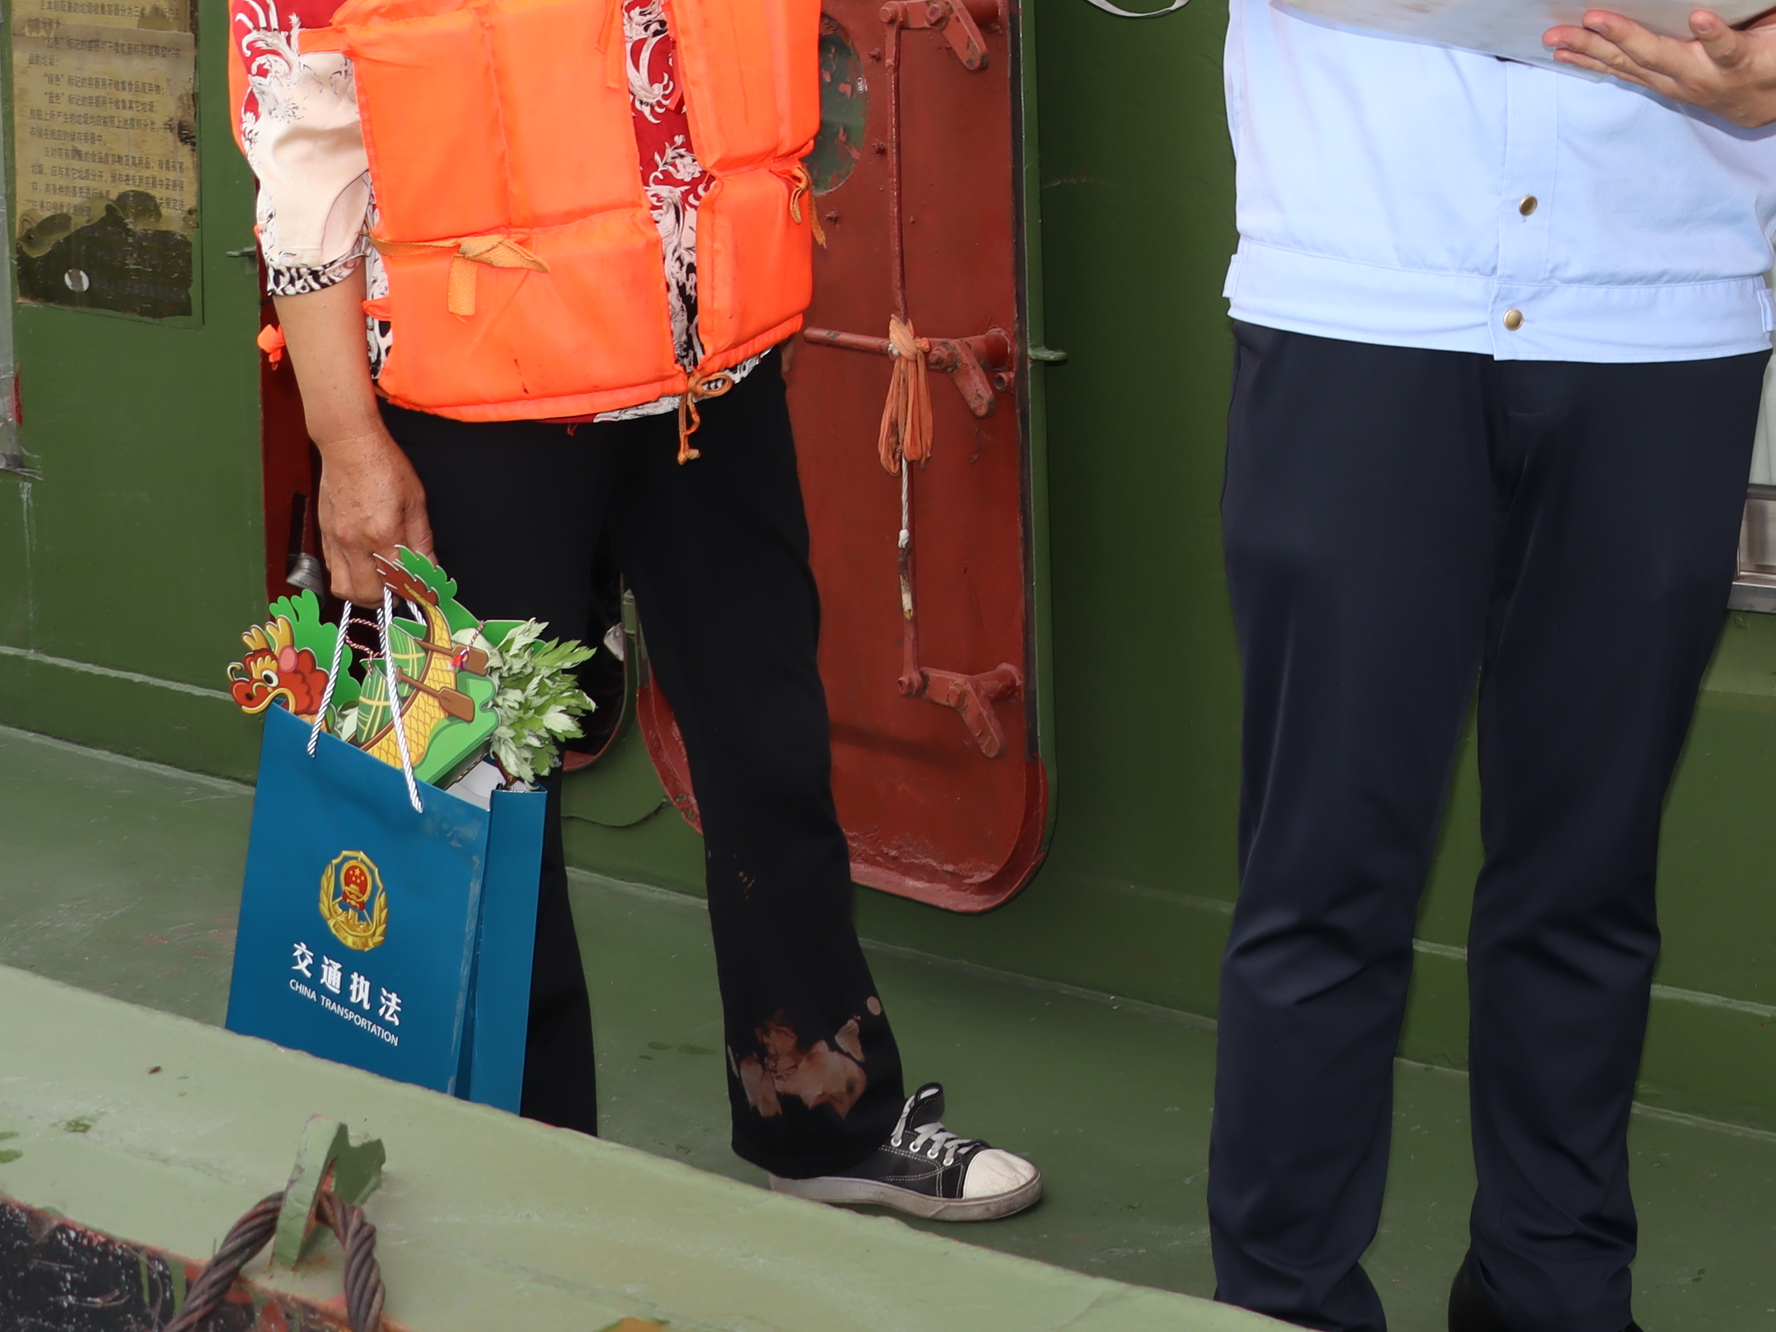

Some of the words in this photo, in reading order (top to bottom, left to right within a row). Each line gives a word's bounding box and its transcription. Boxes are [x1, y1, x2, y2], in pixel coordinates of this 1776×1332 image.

[289, 978, 317, 1002] CHINA
[320, 994, 399, 1047] TRANSPORTATION
[290, 941, 403, 1027] 交通执法
